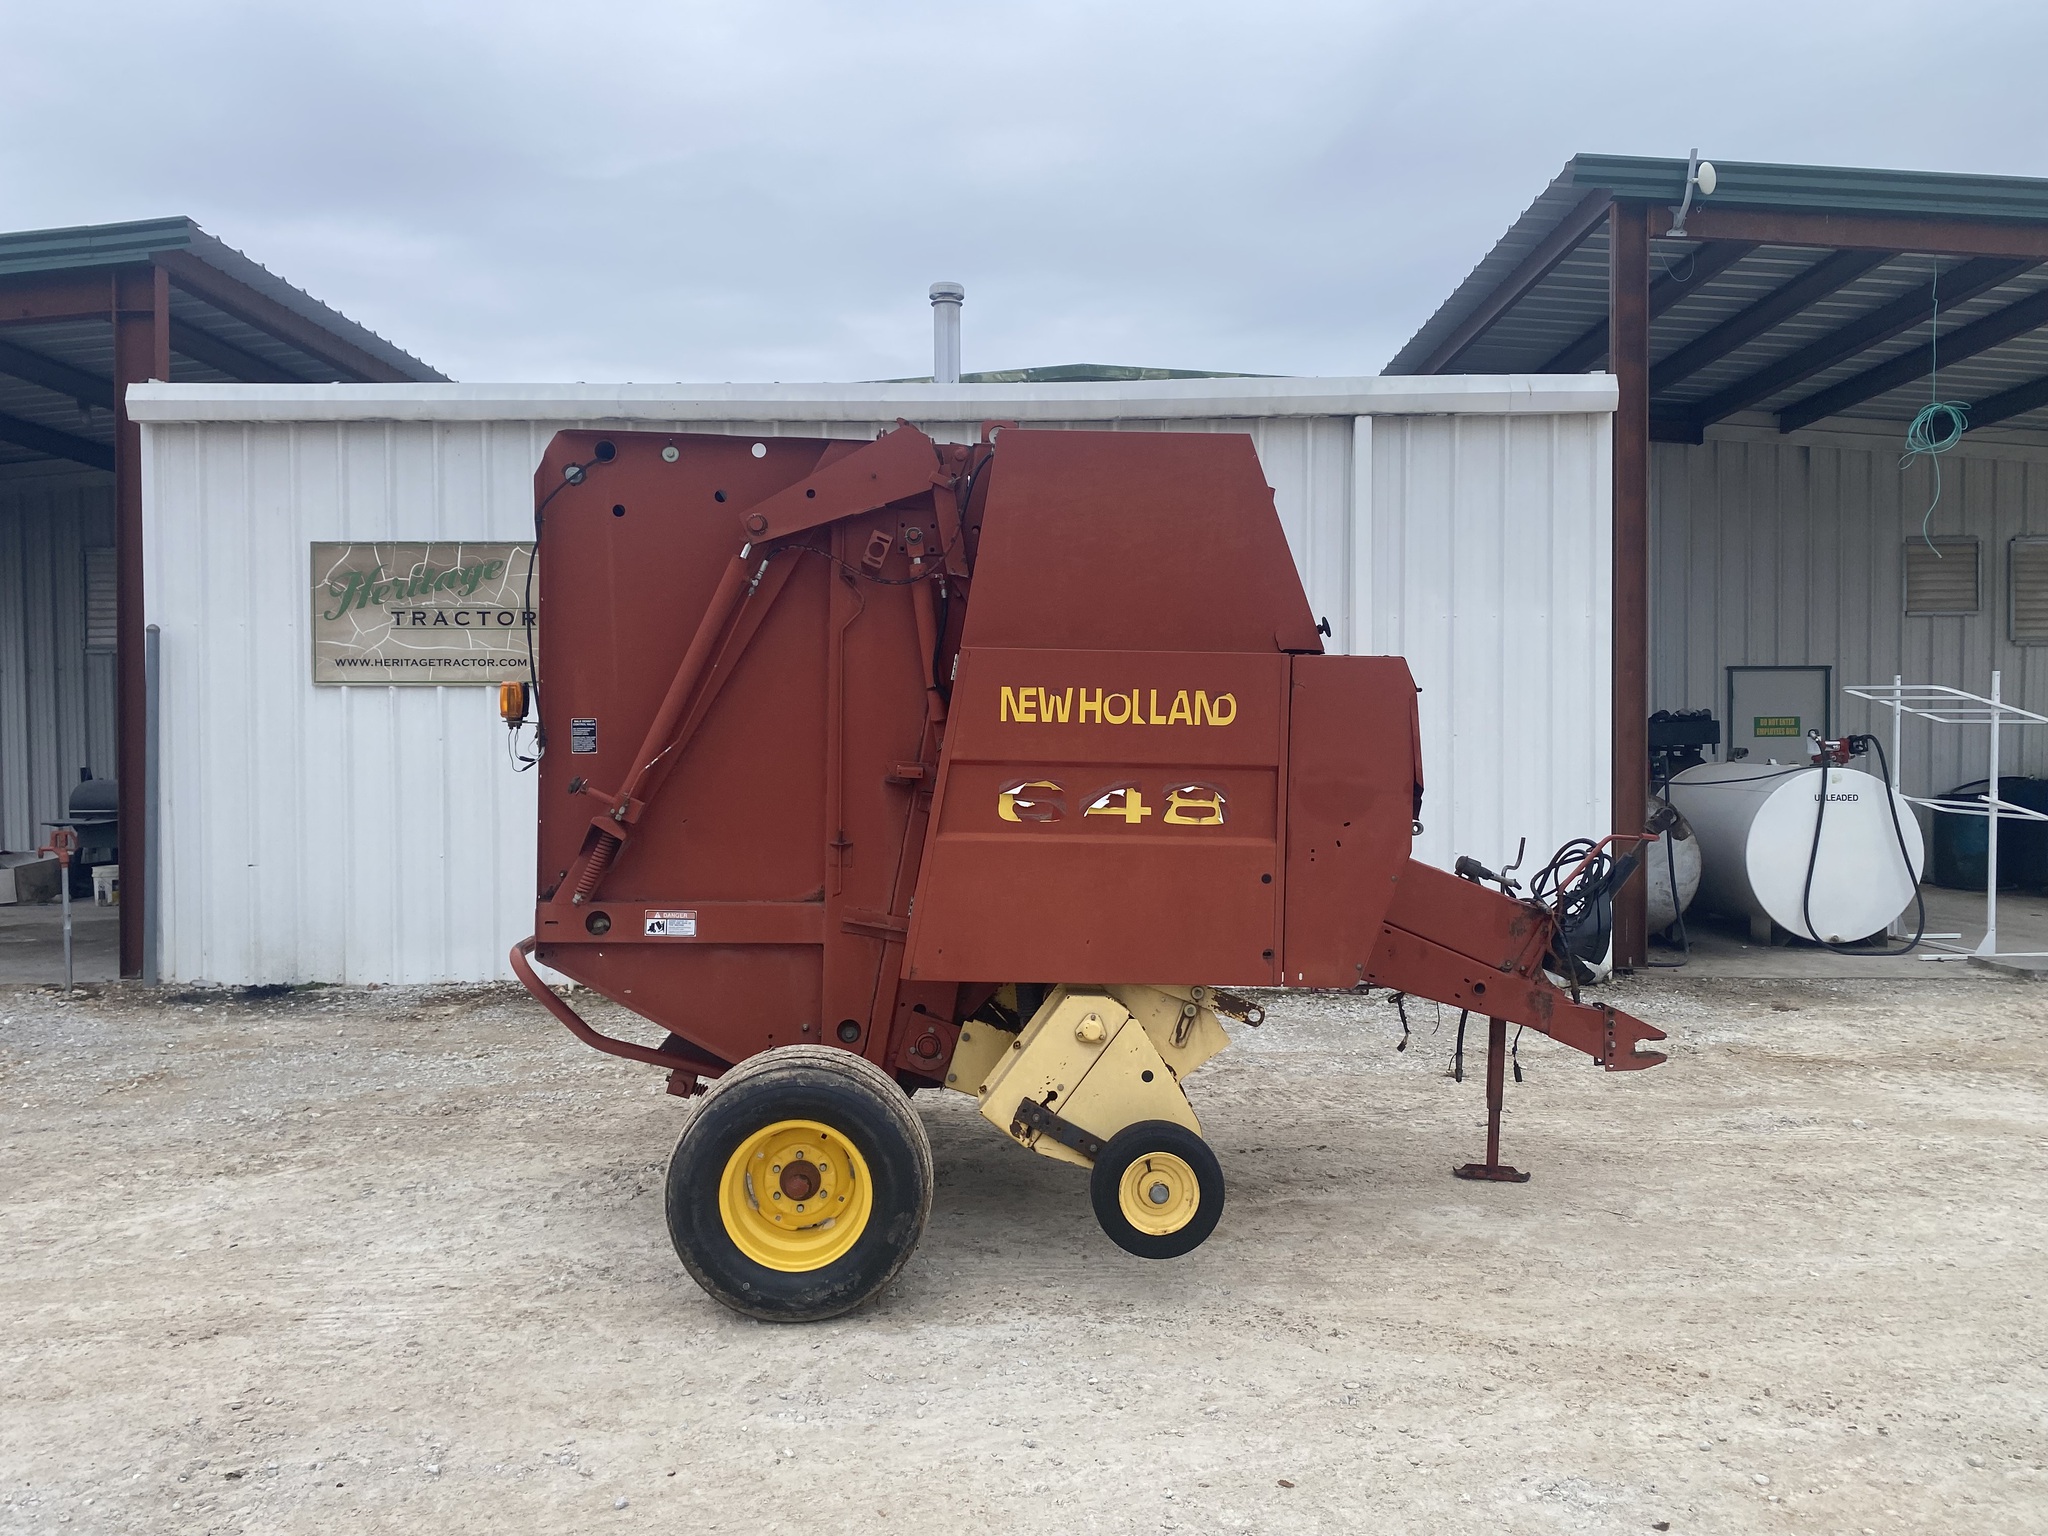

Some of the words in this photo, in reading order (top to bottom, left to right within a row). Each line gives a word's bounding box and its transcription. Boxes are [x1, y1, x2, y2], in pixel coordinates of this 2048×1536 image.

[323, 560, 505, 621] Heritage
[391, 611, 537, 626] TRACTOR
[335, 658, 527, 667] WWW.HERITAGETRACTOR.COM
[1000, 686, 1073, 723] NEW
[1079, 687, 1237, 726] HOLLAND
[1760, 718, 1767, 726] DO
[1768, 718, 1779, 726] NOT
[1814, 793, 1859, 802] ULEADED
